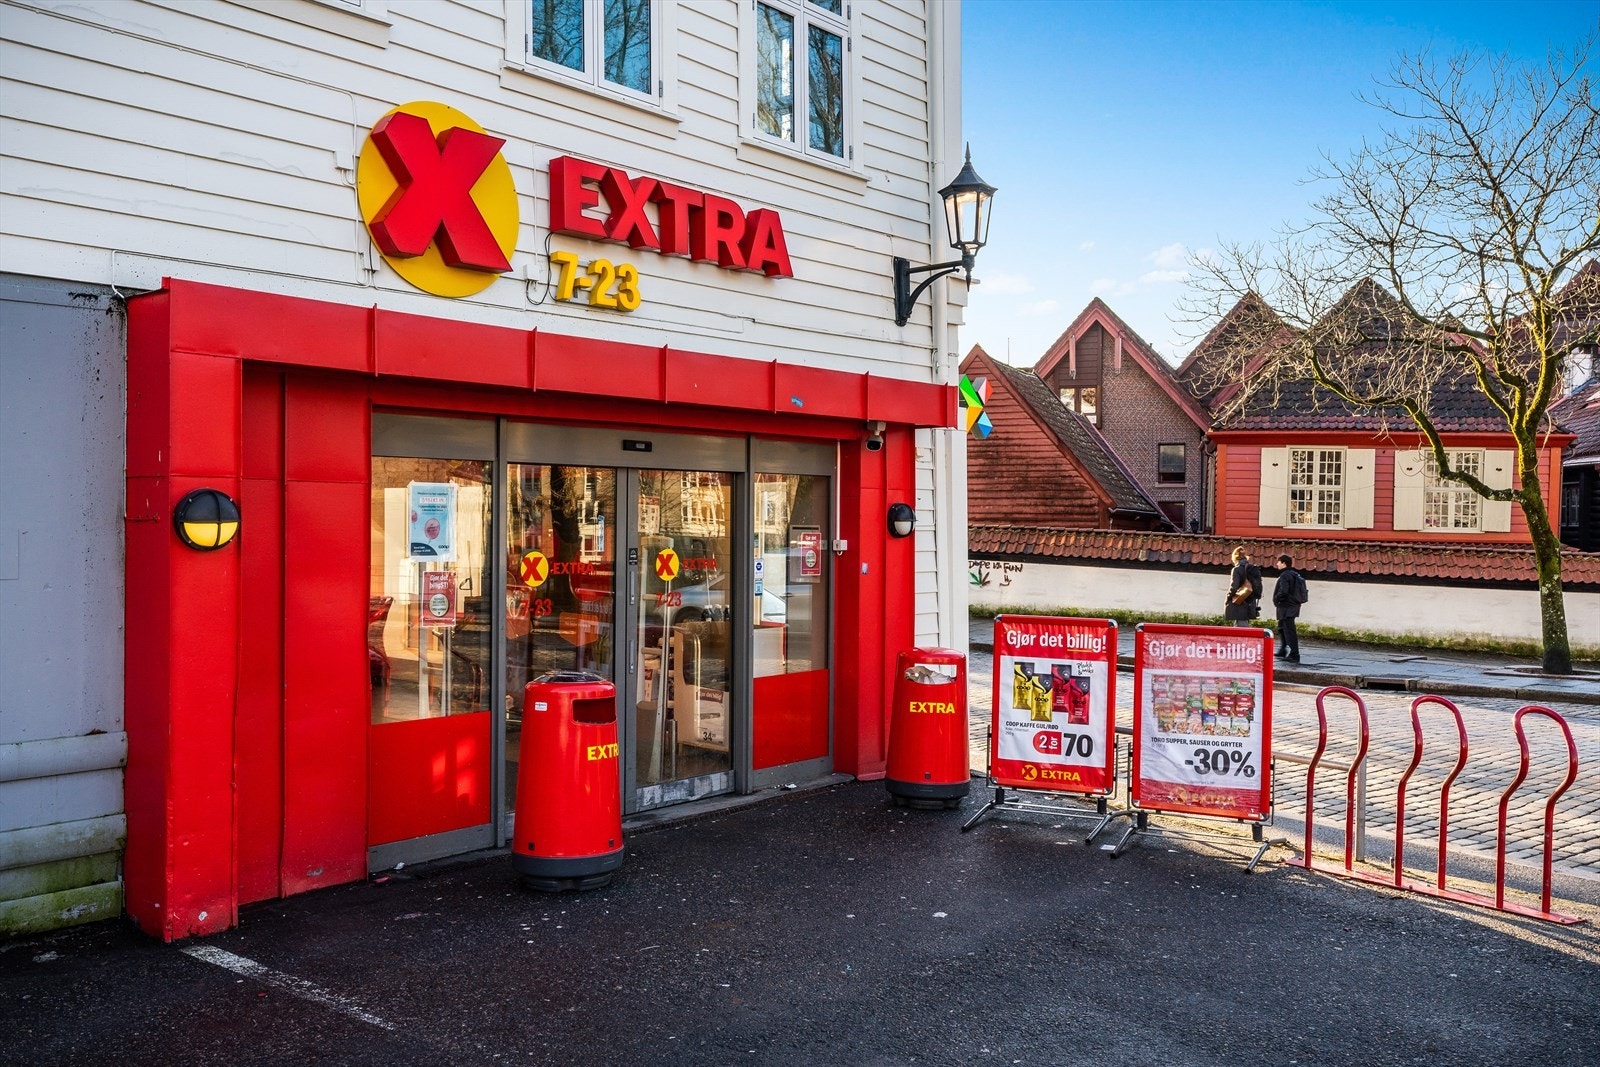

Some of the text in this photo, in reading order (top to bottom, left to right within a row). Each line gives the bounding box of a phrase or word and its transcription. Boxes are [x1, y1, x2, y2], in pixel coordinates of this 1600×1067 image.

[549, 155, 793, 278] EXTRA
[550, 251, 641, 312] 7-23
[553, 562, 595, 575] EXTRA
[683, 558, 718, 570] EXTRA
[520, 598, 552, 617] 7-23
[656, 592, 682, 608] 7-23
[1007, 630, 1106, 653] Gjør det billig!
[1149, 640, 1261, 664] Gjør det billig!
[909, 701, 955, 714] EXTRA
[703, 731, 713, 741] 34
[1039, 732, 1093, 757] 2 for 70
[1184, 748, 1256, 778] -30%
[1041, 770, 1081, 782] EXTRA
[1191, 793, 1236, 807] EXTRA
